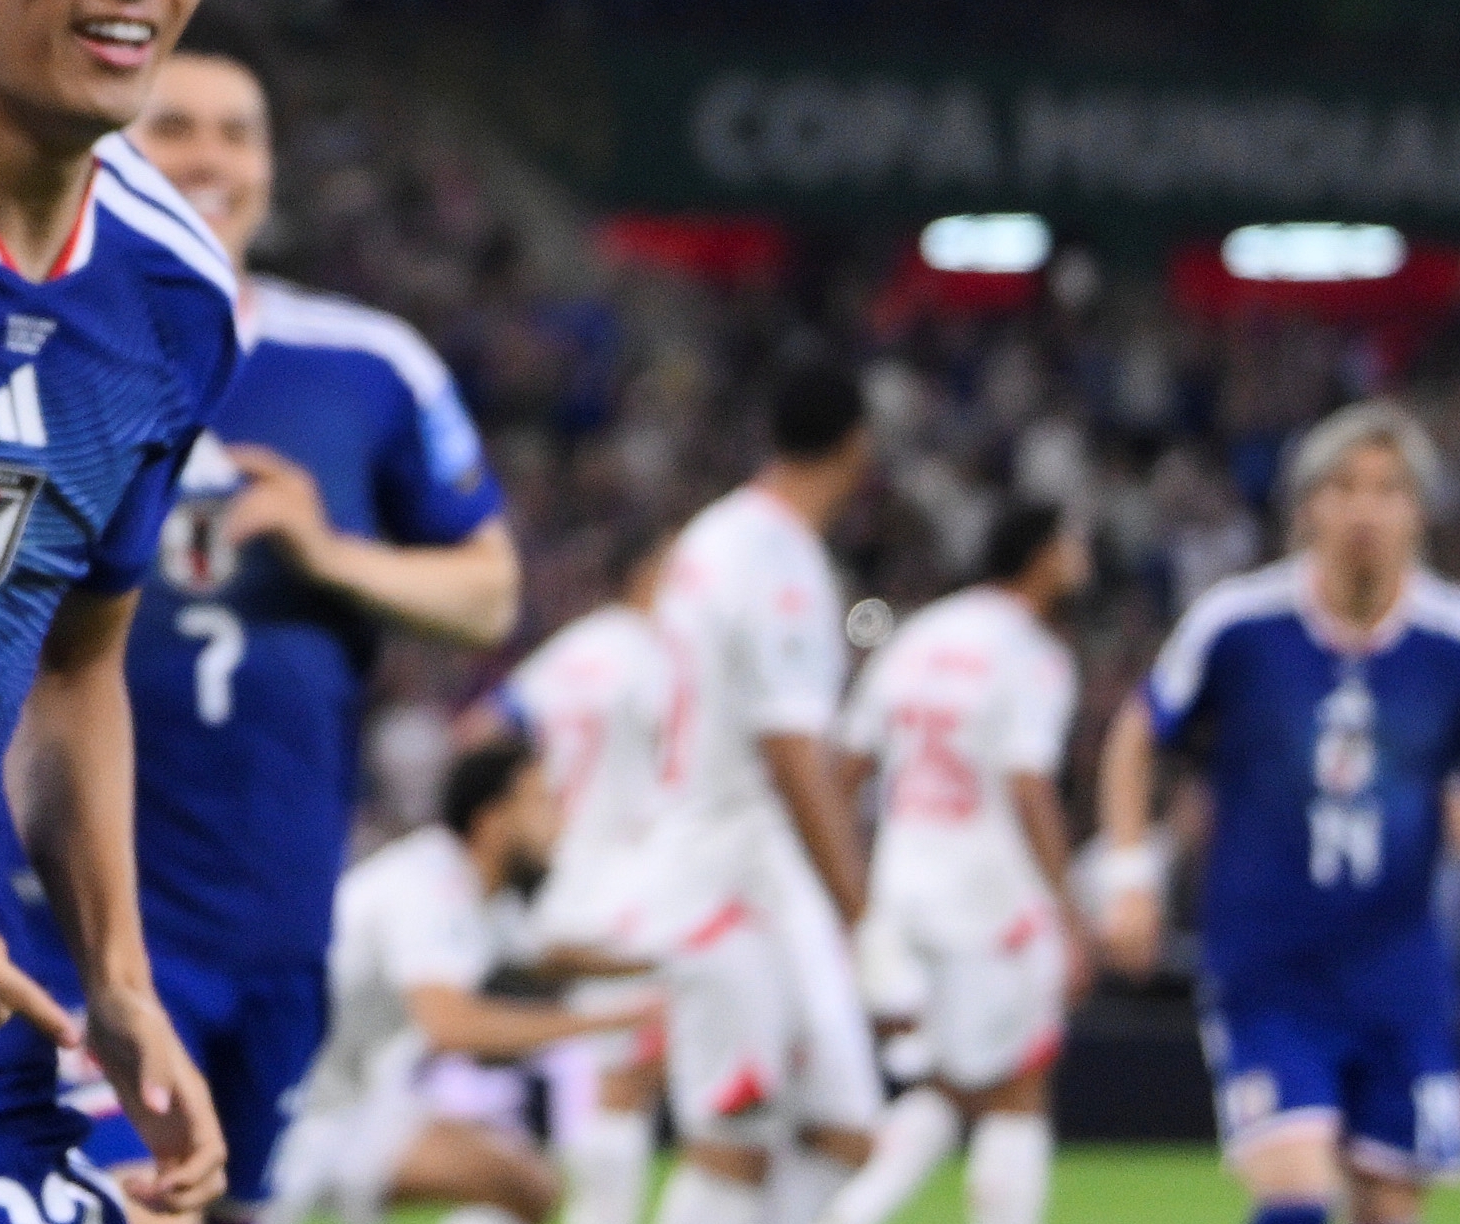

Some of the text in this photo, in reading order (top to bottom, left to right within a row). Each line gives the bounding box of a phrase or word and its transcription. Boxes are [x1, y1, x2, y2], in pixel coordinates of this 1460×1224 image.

[693, 70, 1460, 206] COPA MUNDIA
[177, 604, 244, 724] 7
